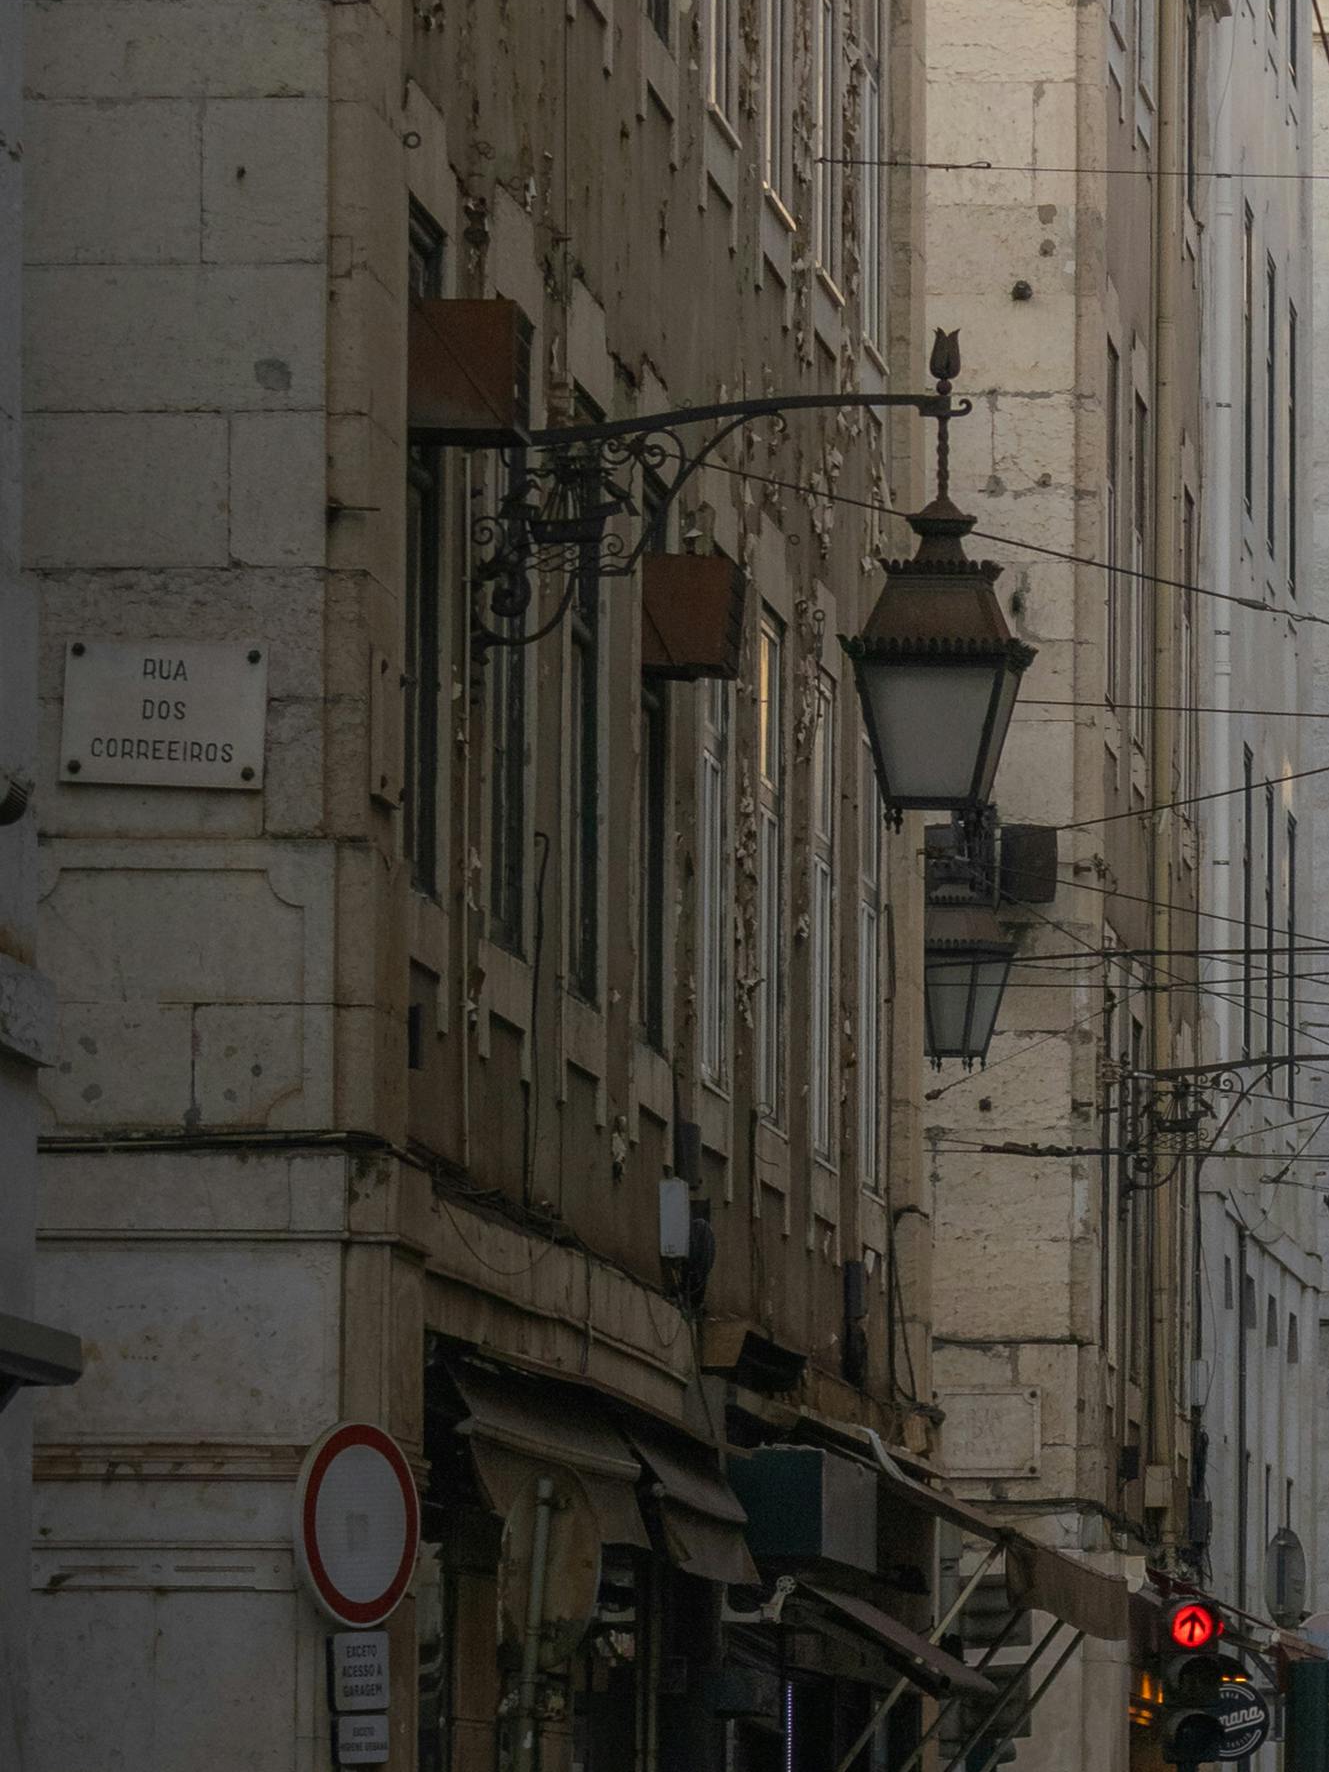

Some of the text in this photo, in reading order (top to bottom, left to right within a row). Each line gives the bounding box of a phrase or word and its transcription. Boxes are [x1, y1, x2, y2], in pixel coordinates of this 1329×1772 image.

[143, 658, 188, 682] RUA
[142, 700, 186, 721] DOS
[90, 736, 235, 764] CORREEIROS
[346, 1644, 378, 1659] EXCETO
[342, 1662, 375, 1678] ACESSO
[343, 1683, 383, 1698] GARAGEM
[352, 1726, 376, 1738] EXCETO
